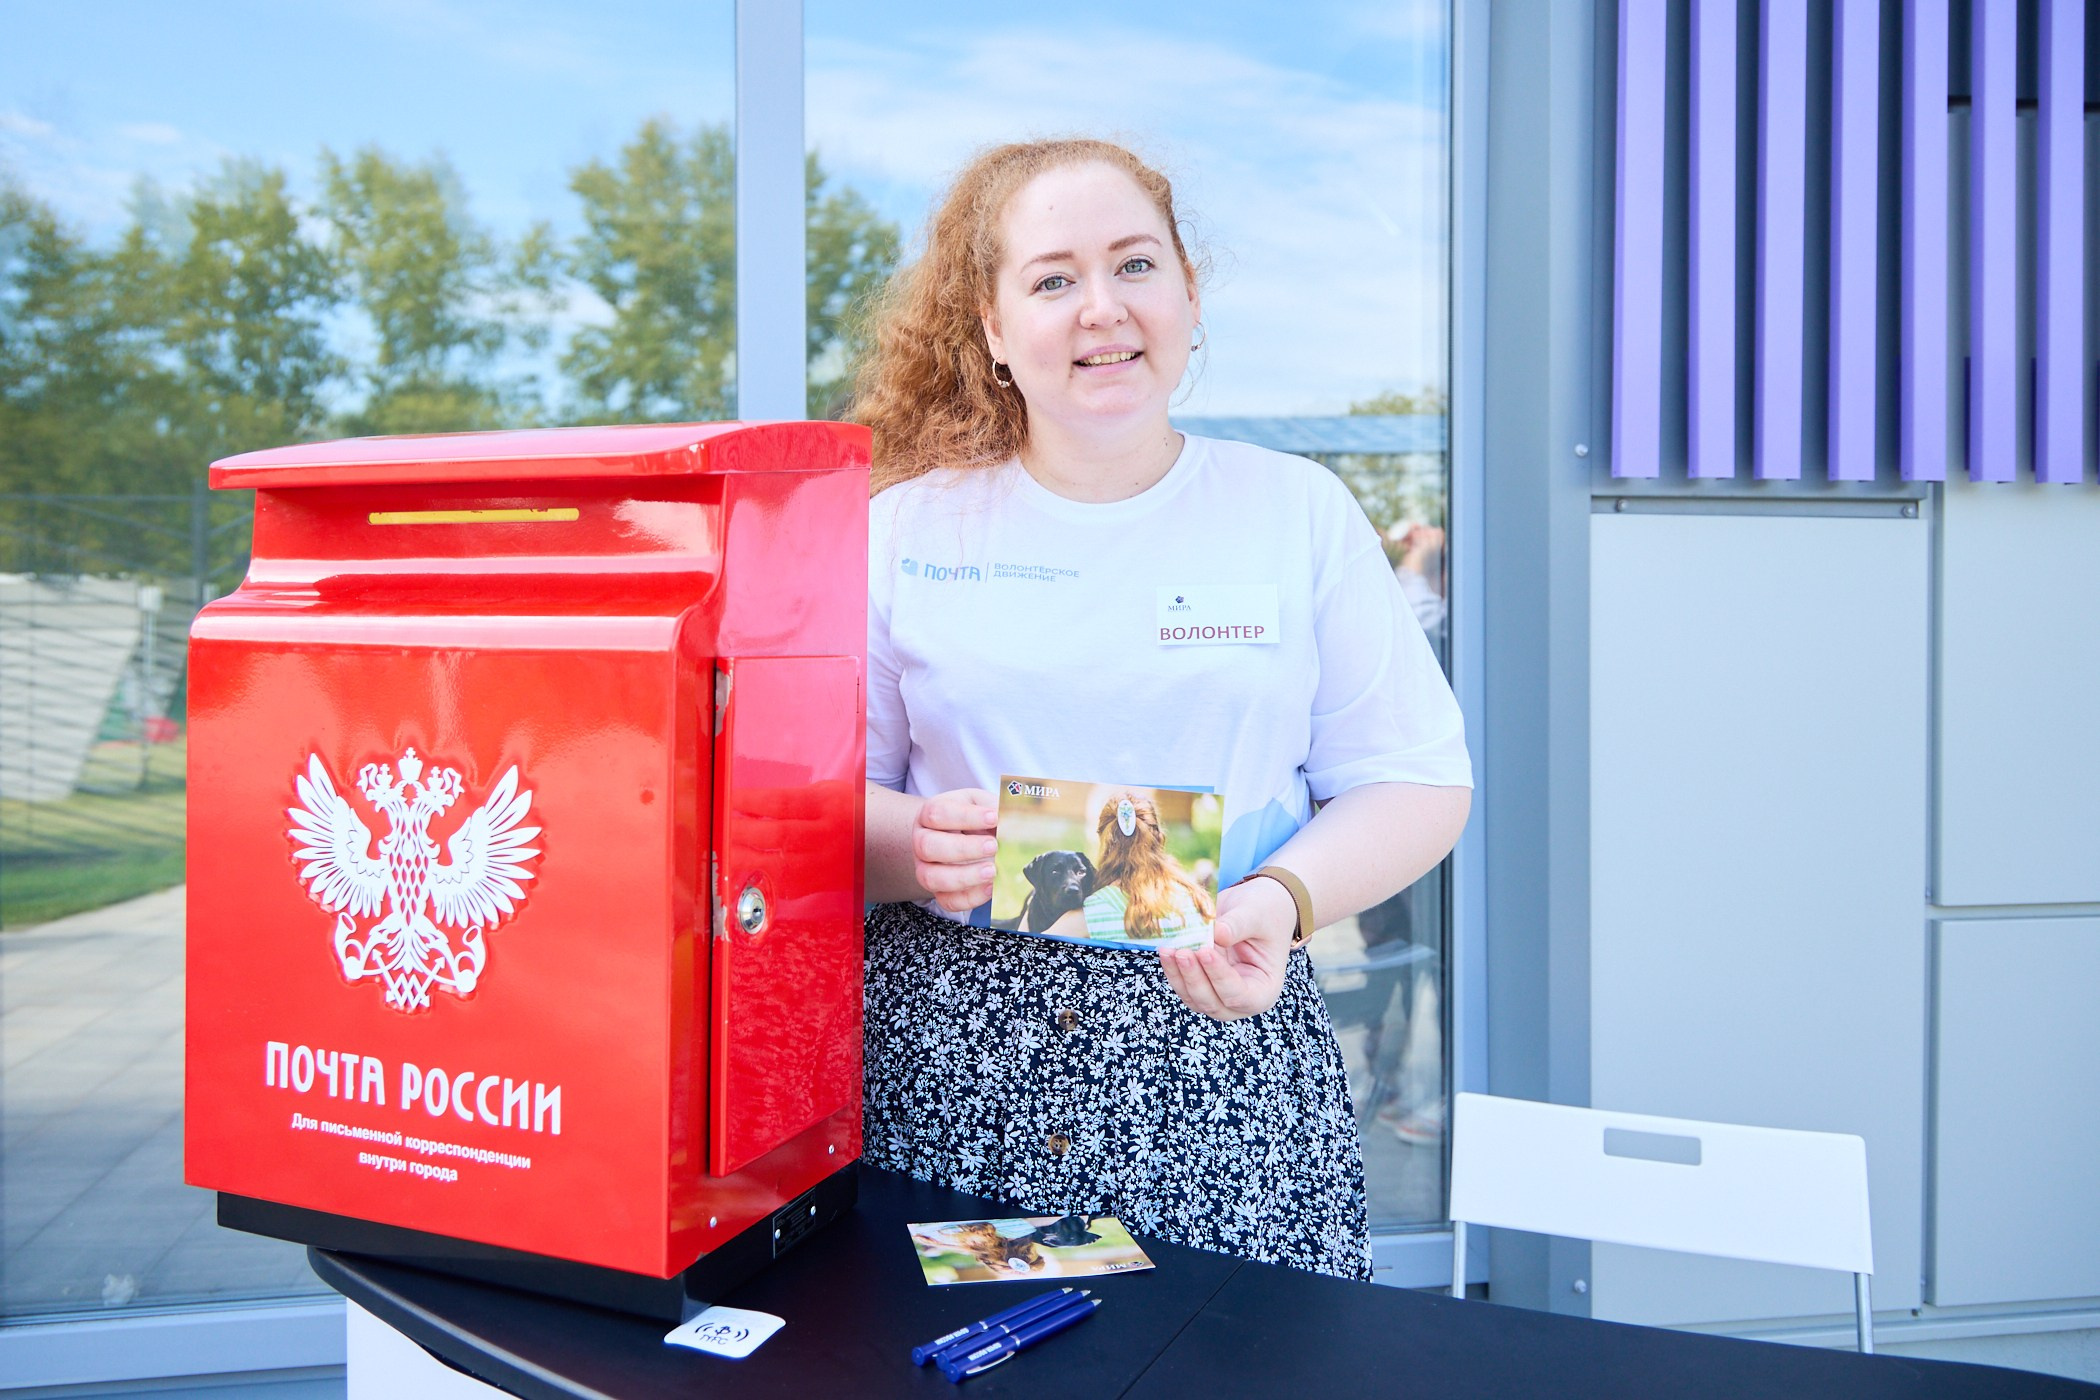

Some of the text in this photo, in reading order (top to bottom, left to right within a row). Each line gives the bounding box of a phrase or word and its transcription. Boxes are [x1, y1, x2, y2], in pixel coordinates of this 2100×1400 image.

[924, 563, 981, 581] ПОЧТА
[993, 570, 1056, 582] ДВИЖЕНИЕ
[1167, 604, 1192, 612] МИРА
[1160, 626, 1265, 640] ВОЛОНТЕР
[1024, 785, 1060, 797] МИРА
[265, 1041, 561, 1135] ПОЧТА РОССИИ
[292, 1113, 531, 1169] Для письменной корреспонденции
[359, 1152, 458, 1181] внутри города
